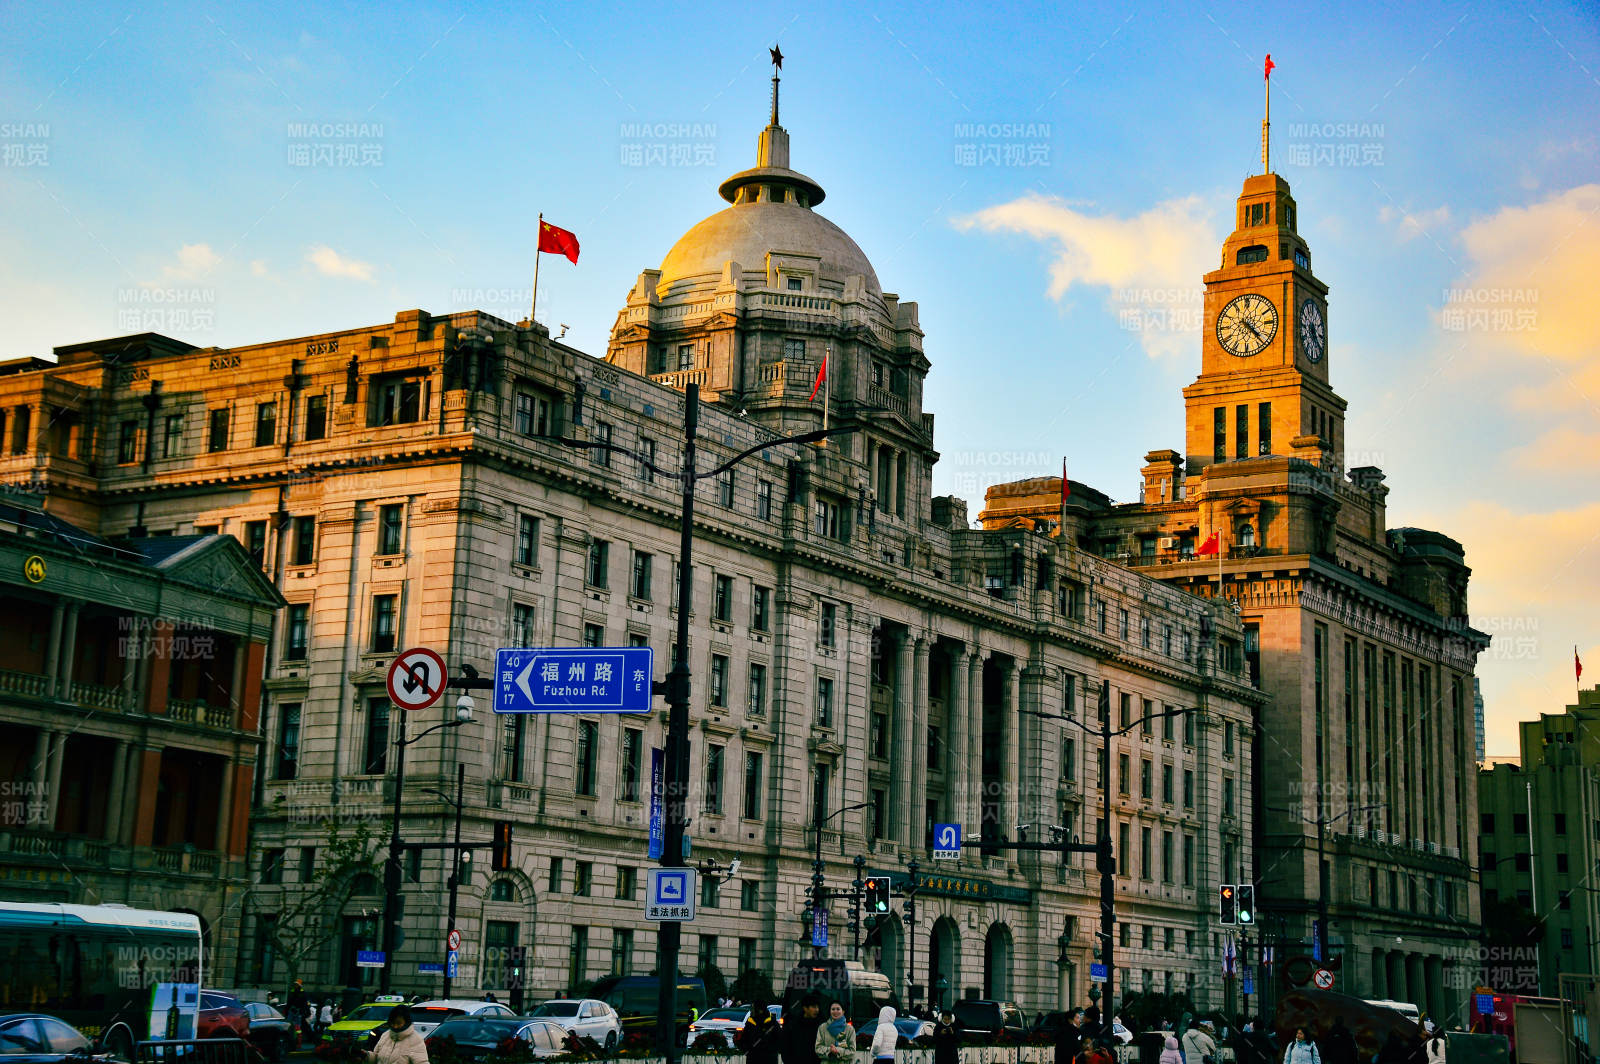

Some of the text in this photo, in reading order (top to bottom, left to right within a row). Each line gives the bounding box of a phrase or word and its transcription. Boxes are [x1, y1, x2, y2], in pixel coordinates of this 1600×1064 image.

[506, 657, 520, 668] 40
[502, 671, 513, 682] 西
[541, 662, 613, 682] 福州路
[633, 669, 645, 682] 东
[503, 684, 511, 692] W
[543, 685, 608, 696] Fuzhou Rd.
[635, 684, 641, 692] E
[504, 694, 515, 705] 17
[650, 906, 689, 918] 违法抓拍
